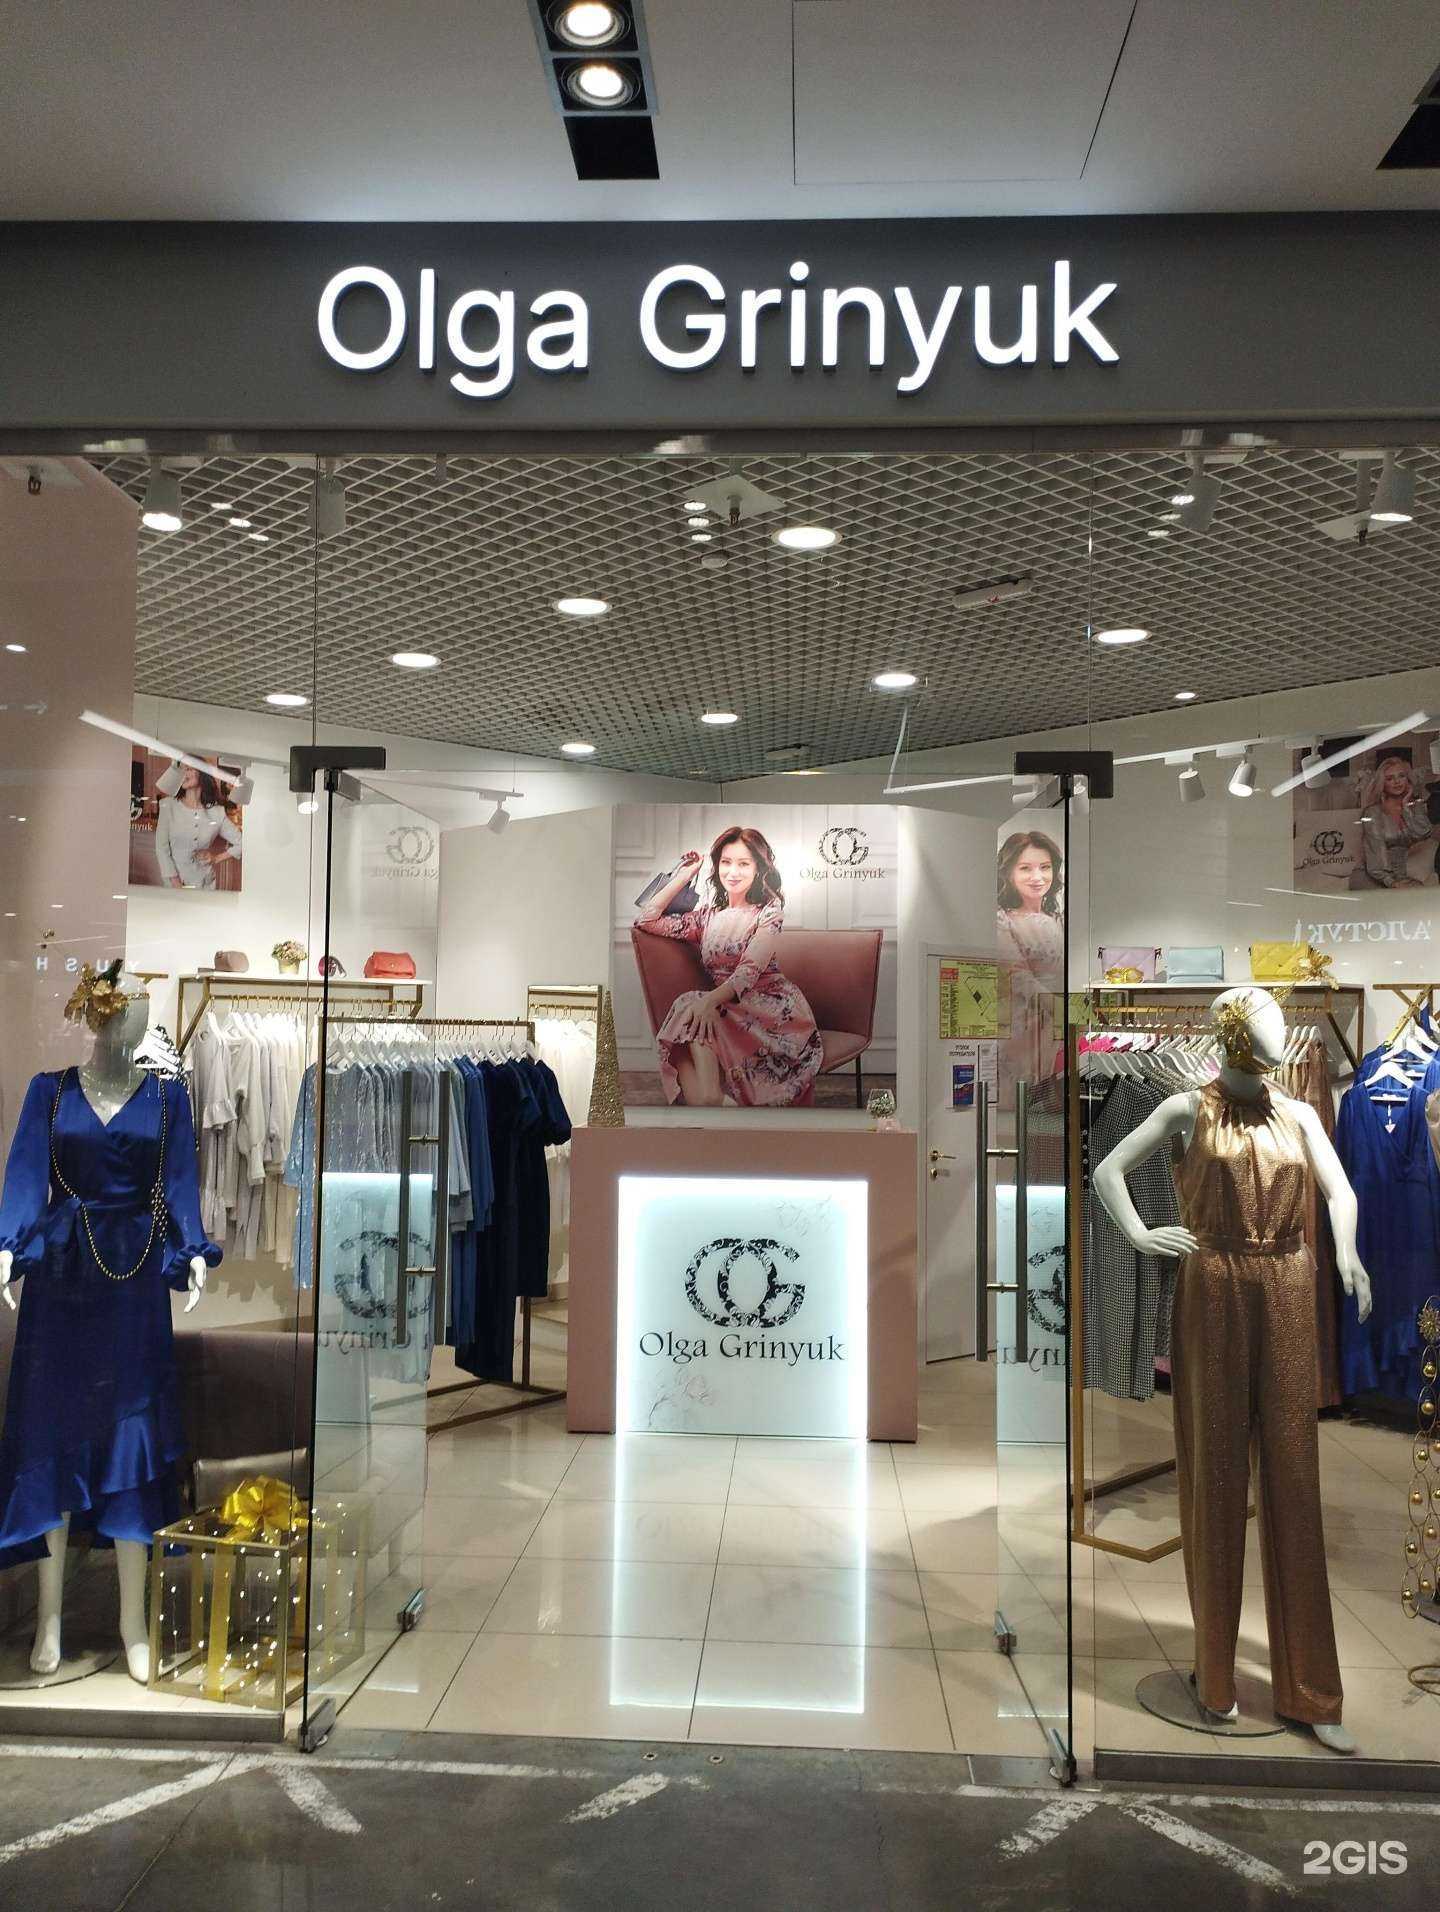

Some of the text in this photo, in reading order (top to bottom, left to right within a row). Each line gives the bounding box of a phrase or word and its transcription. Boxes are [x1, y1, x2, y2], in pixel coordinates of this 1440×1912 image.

[317, 260, 1120, 398] Olga Grinyuk
[800, 867, 885, 882] Olga Grinyuk
[639, 1331, 847, 1367] Olga Grinyuk
